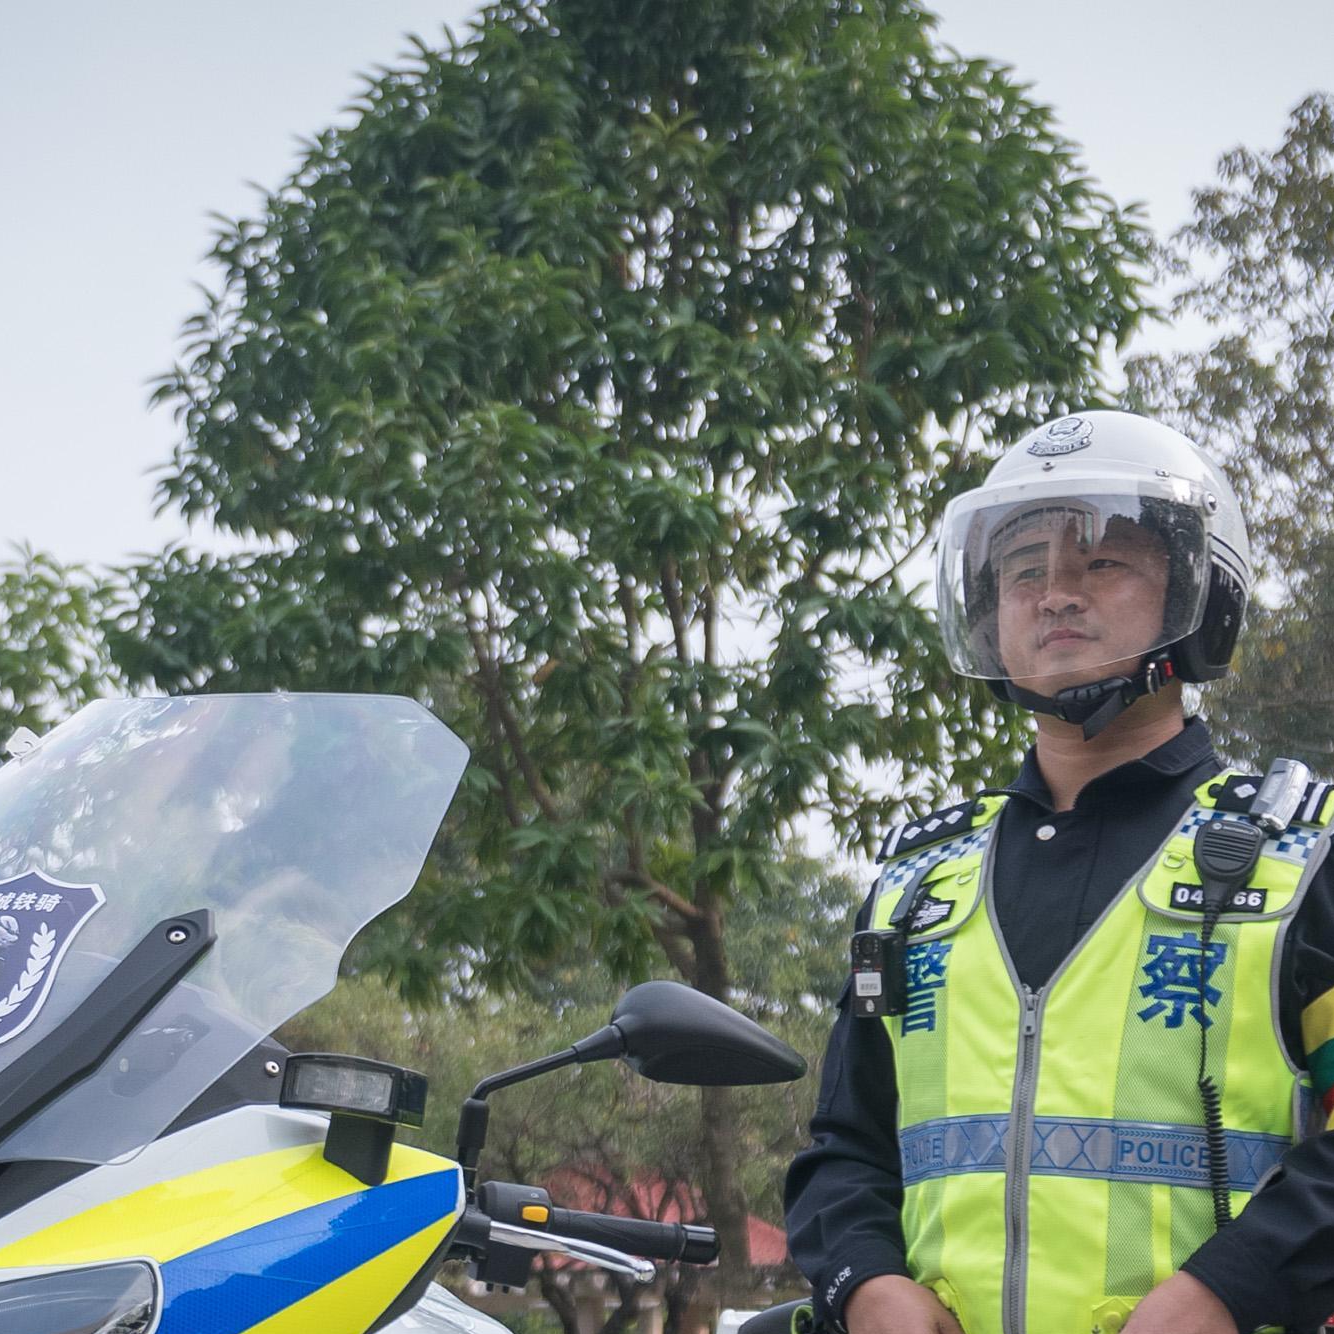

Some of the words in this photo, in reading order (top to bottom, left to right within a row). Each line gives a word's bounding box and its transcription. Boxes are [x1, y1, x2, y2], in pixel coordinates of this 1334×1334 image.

[1175, 887, 1262, 907] 0466
[1137, 932, 1228, 1029] 察
[1120, 1139, 1212, 1169] POLICE
[827, 1266, 852, 1306] POLICE
